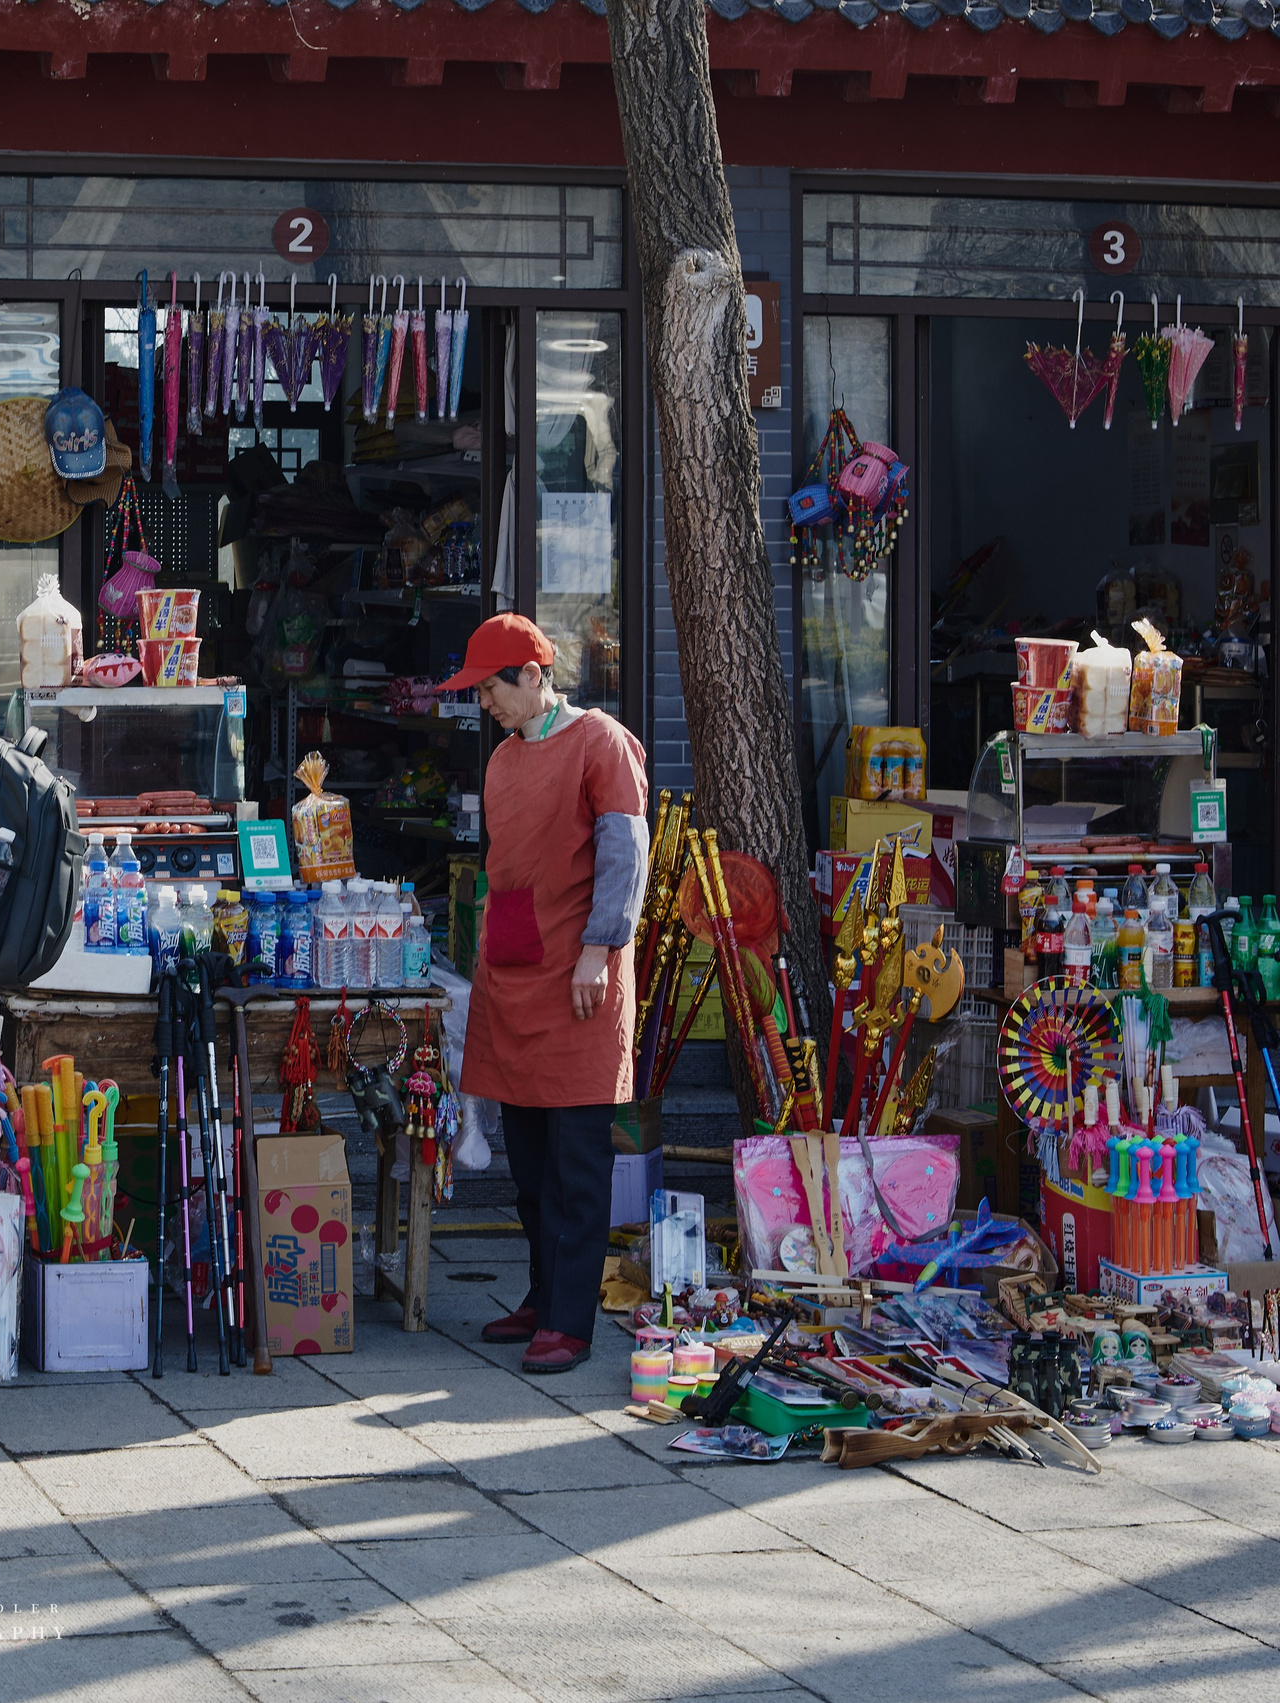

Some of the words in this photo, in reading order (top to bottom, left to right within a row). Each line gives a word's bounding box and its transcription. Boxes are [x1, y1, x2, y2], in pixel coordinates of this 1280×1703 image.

[288, 217, 313, 253] 2
[1103, 230, 1125, 265] 3
[52, 428, 99, 452] Girls
[266, 1234, 306, 1308] 脉动
[309, 1260, 320, 1307] 桃子口味
[1181, 1285, 1208, 1297] 洋剑
